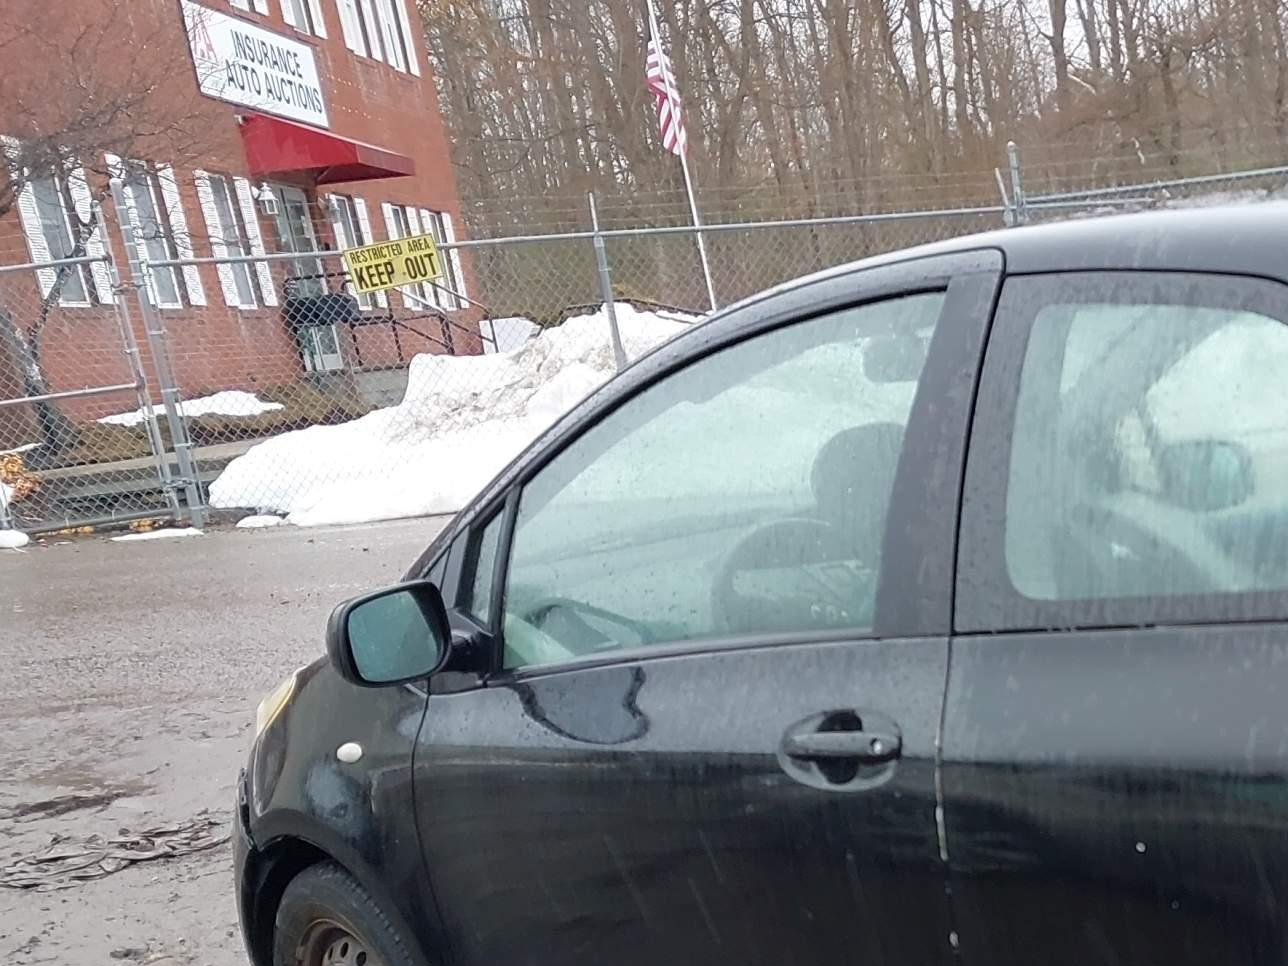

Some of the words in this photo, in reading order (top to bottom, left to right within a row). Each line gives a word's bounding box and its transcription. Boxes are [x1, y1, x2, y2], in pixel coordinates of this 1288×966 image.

[231, 29, 303, 79] INSURANCE
[225, 58, 262, 96] AUTO
[264, 72, 323, 114] AUCTIONS
[349, 243, 403, 265] RESTRICTED
[407, 238, 431, 253] AREA
[353, 260, 395, 290] KEEP
[404, 253, 437, 280] OUT
